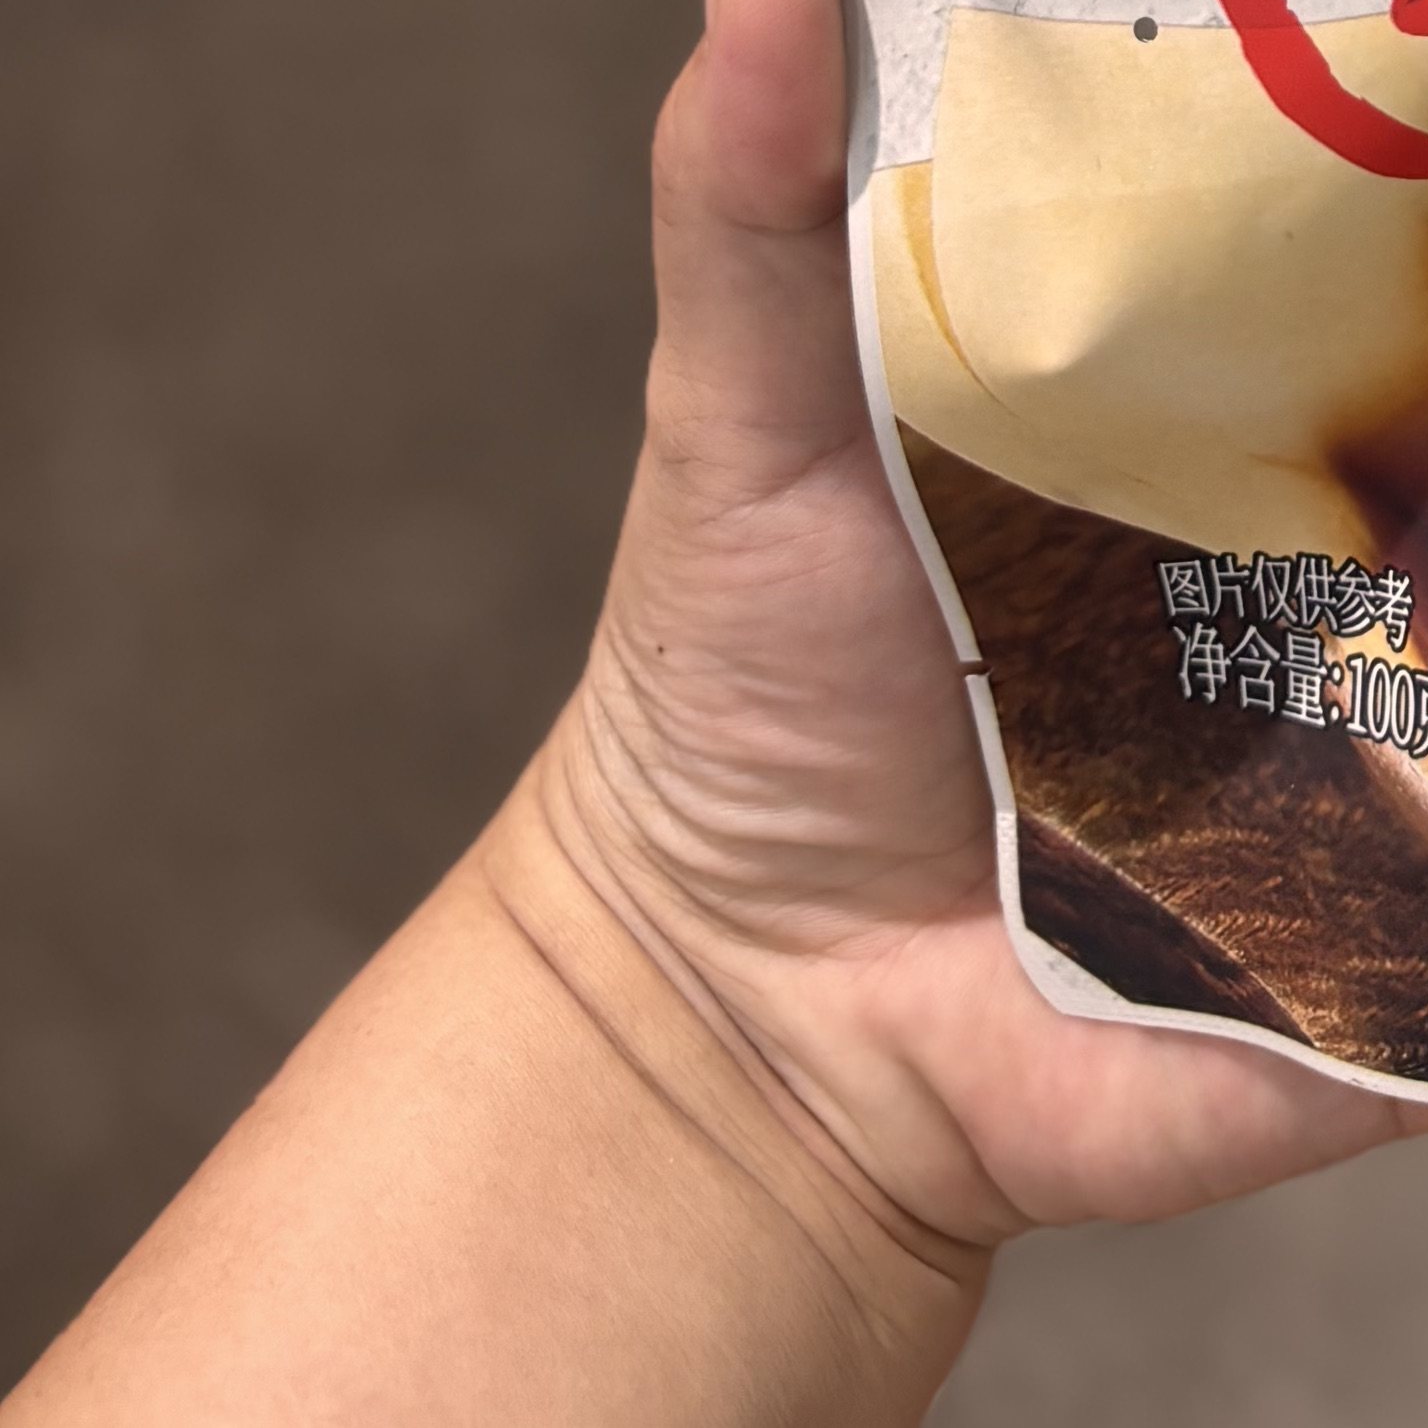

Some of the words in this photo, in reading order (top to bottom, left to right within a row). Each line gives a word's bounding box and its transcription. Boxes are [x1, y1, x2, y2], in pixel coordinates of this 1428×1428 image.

[1158, 555, 1412, 647] 图片仅供参考
